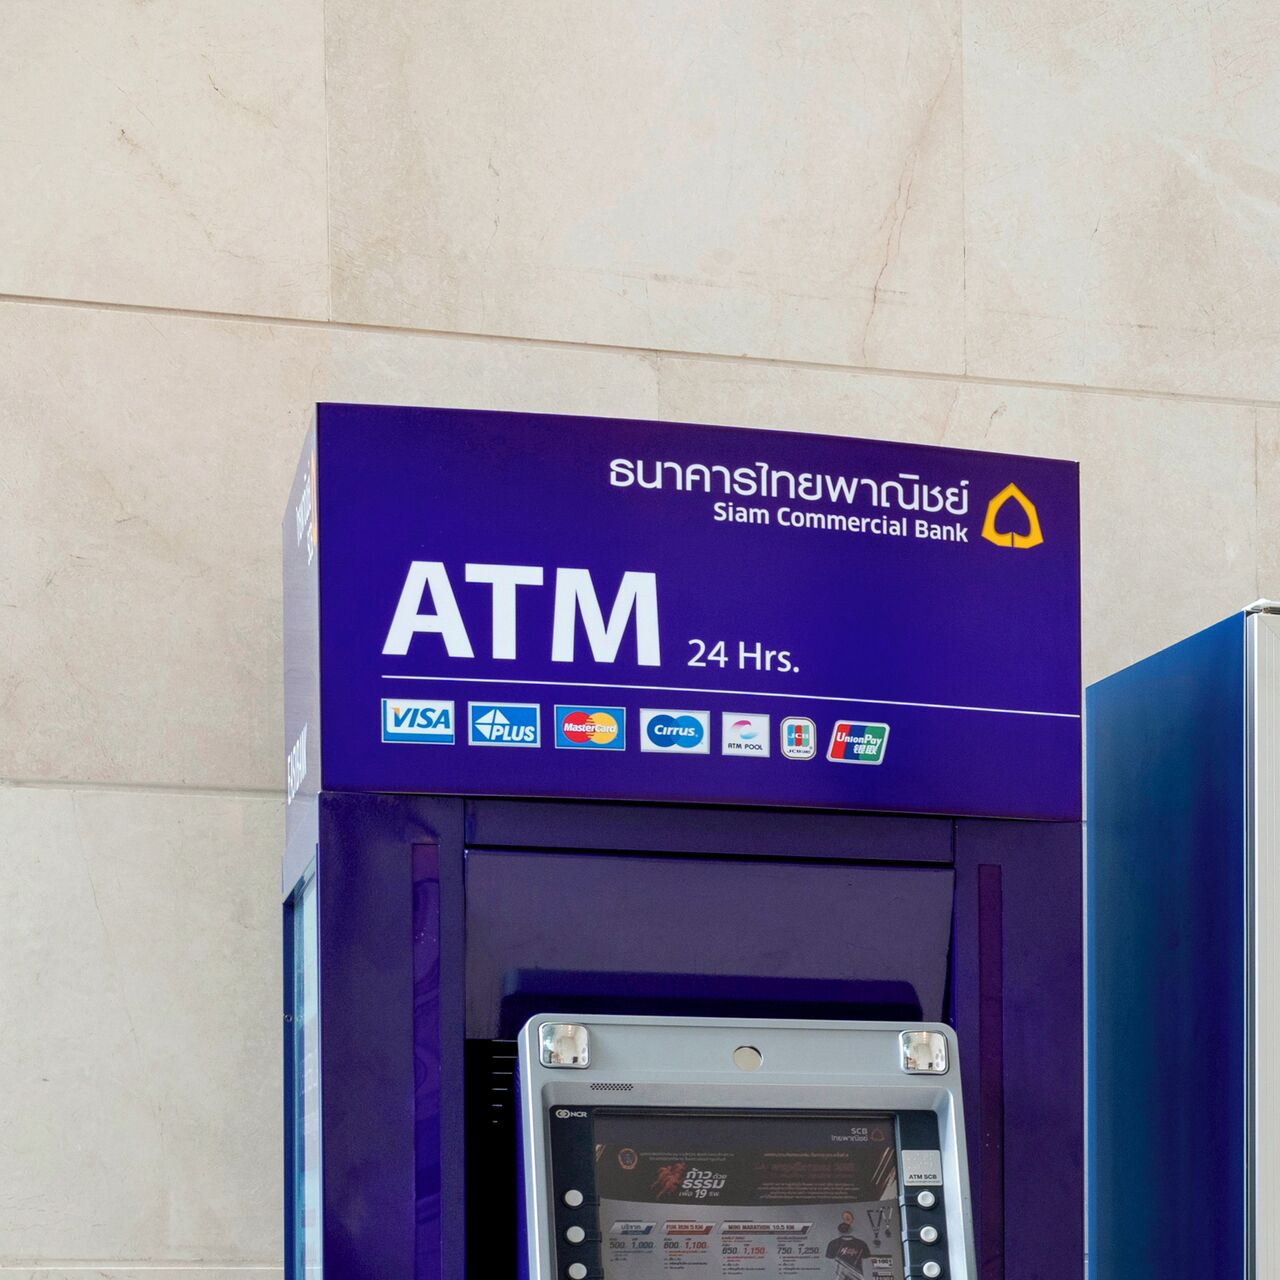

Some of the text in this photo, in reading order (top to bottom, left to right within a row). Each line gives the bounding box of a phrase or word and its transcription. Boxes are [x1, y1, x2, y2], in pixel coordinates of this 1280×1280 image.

[609, 458, 970, 516] ธนาคารไทยพาณิชย์
[713, 501, 969, 543] Siam Commercial Bank
[381, 560, 662, 667] ATM
[687, 640, 800, 674] 24 Hrs.
[393, 707, 451, 730] VISA
[491, 725, 535, 742] PLUS
[563, 722, 617, 734] MasterCard
[654, 724, 695, 738] Cirrus
[836, 731, 883, 747] UnionPay
[744, 743, 763, 751] POOL
[851, 1127, 868, 1135] SCB
[686, 1168, 712, 1180] ก้าว
[682, 1179, 726, 1189] ธรรม
[694, 1189, 708, 1199] 19
